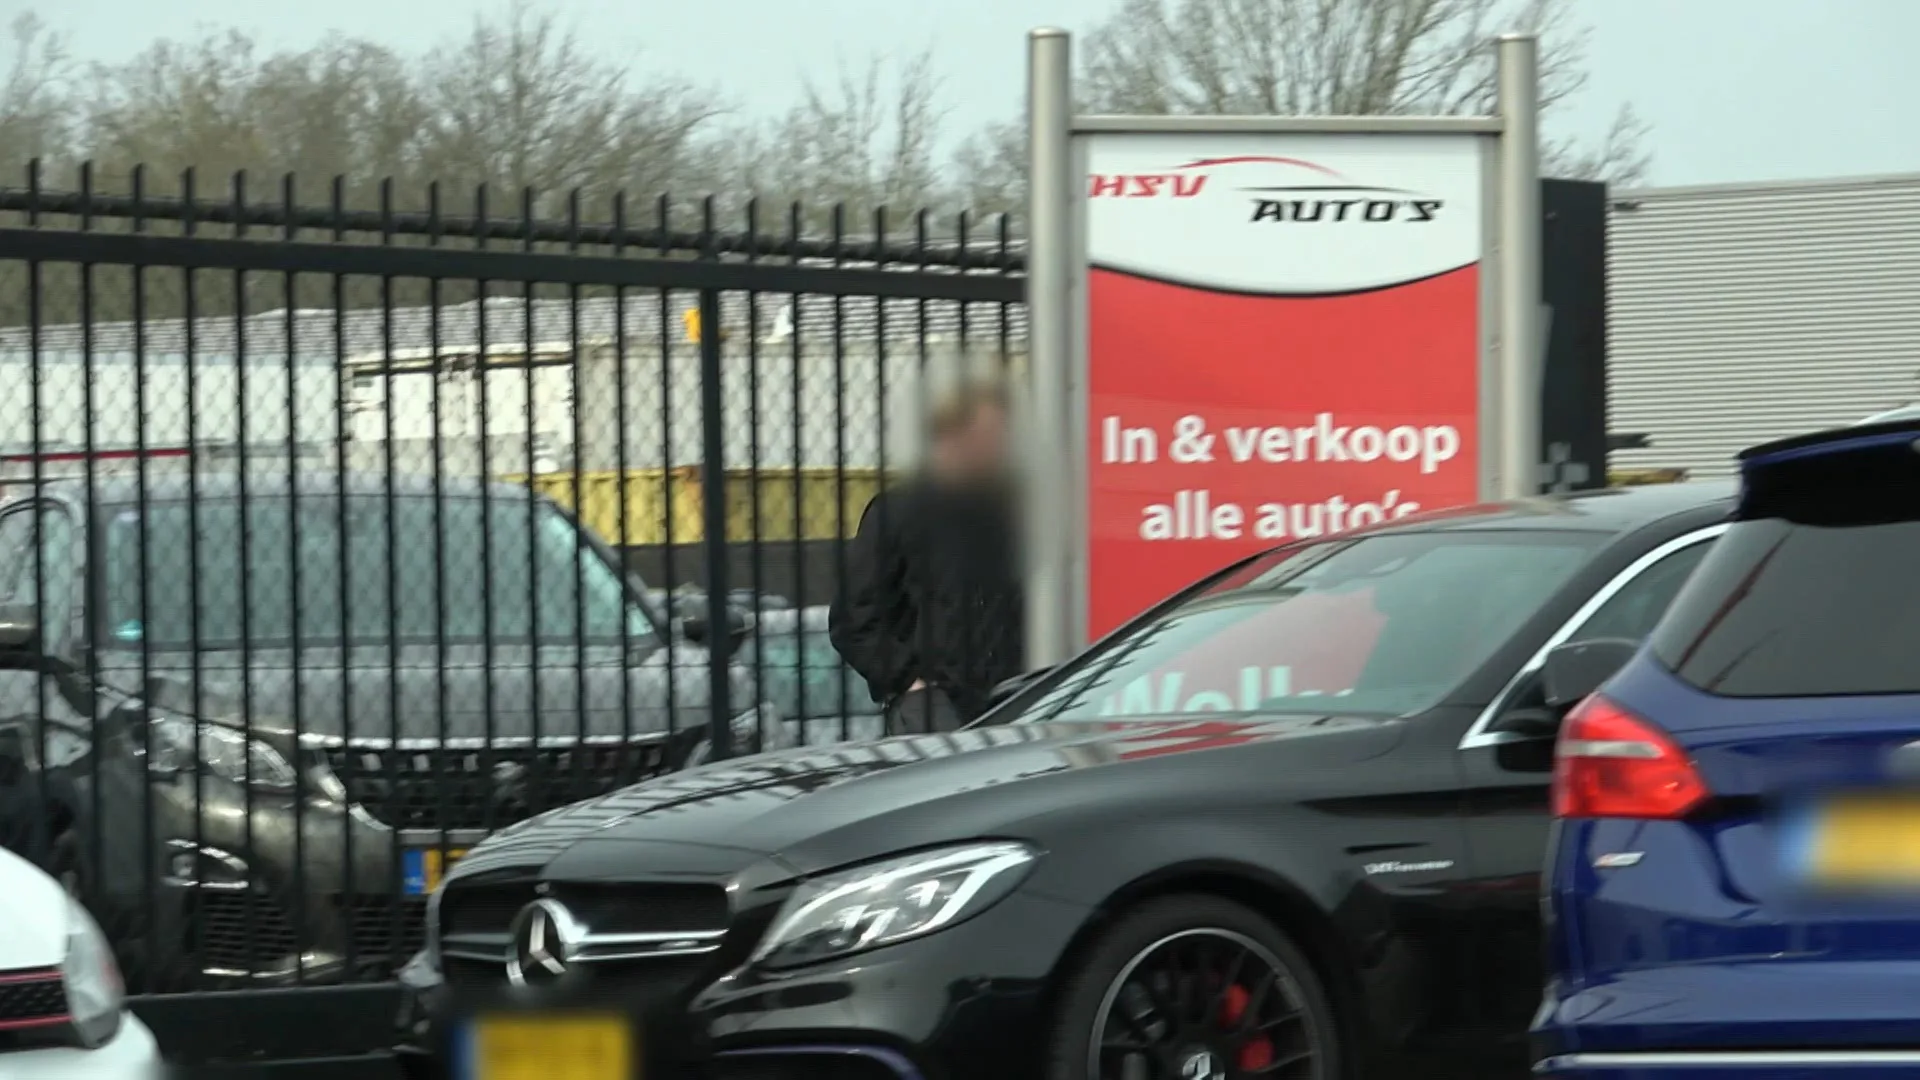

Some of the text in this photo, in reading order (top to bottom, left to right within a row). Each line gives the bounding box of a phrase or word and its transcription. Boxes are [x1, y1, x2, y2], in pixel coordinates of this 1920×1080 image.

[1089, 174, 1208, 199] HSV
[1250, 199, 1444, 223] AUTO'S
[1101, 412, 1461, 474] In & verkoop
[1139, 489, 1245, 540] alle
